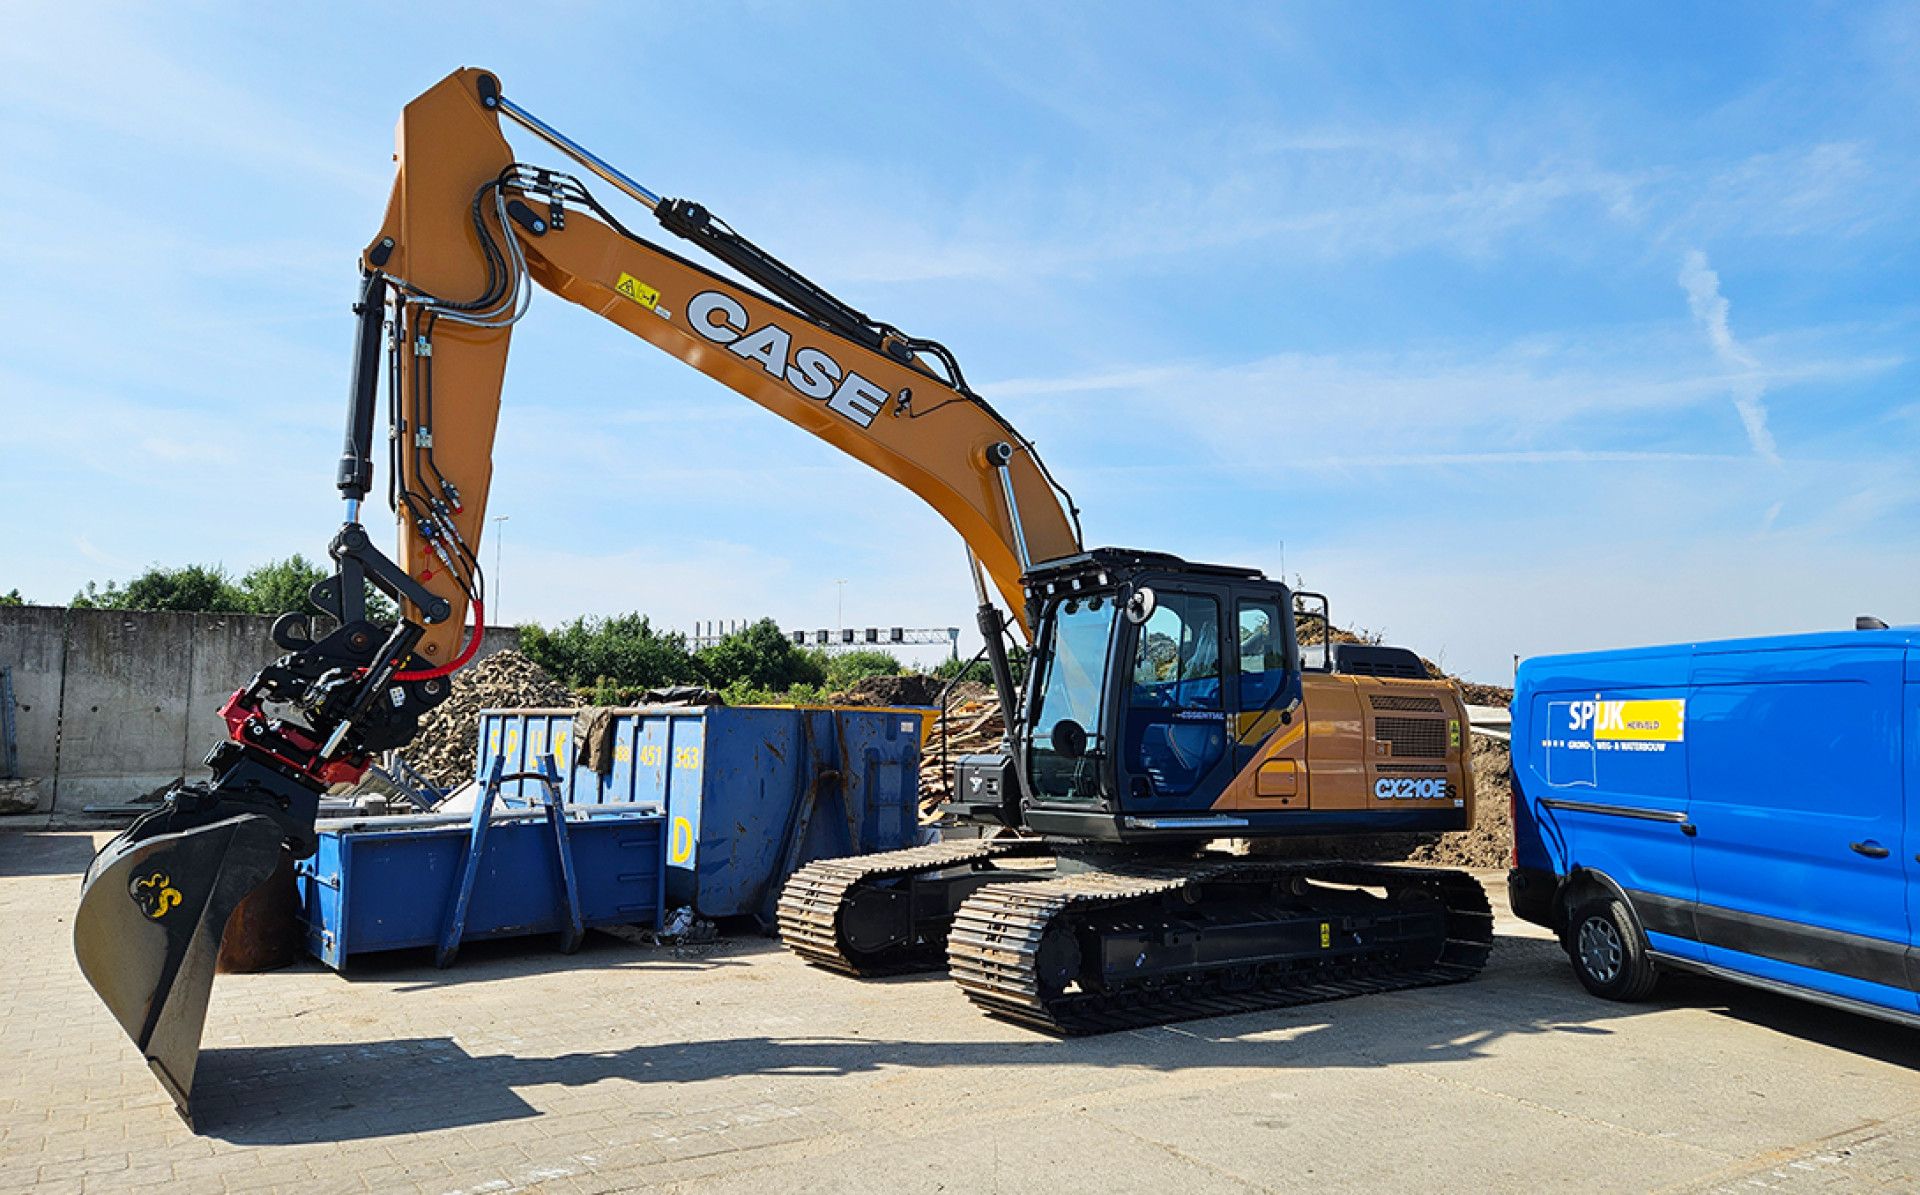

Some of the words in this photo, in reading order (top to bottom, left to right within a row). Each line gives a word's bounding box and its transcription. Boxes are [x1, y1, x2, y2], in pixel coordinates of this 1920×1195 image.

[686, 290, 891, 430] CASE
[640, 745, 662, 768] 451
[674, 747, 699, 769] 363
[672, 816, 693, 863] D
